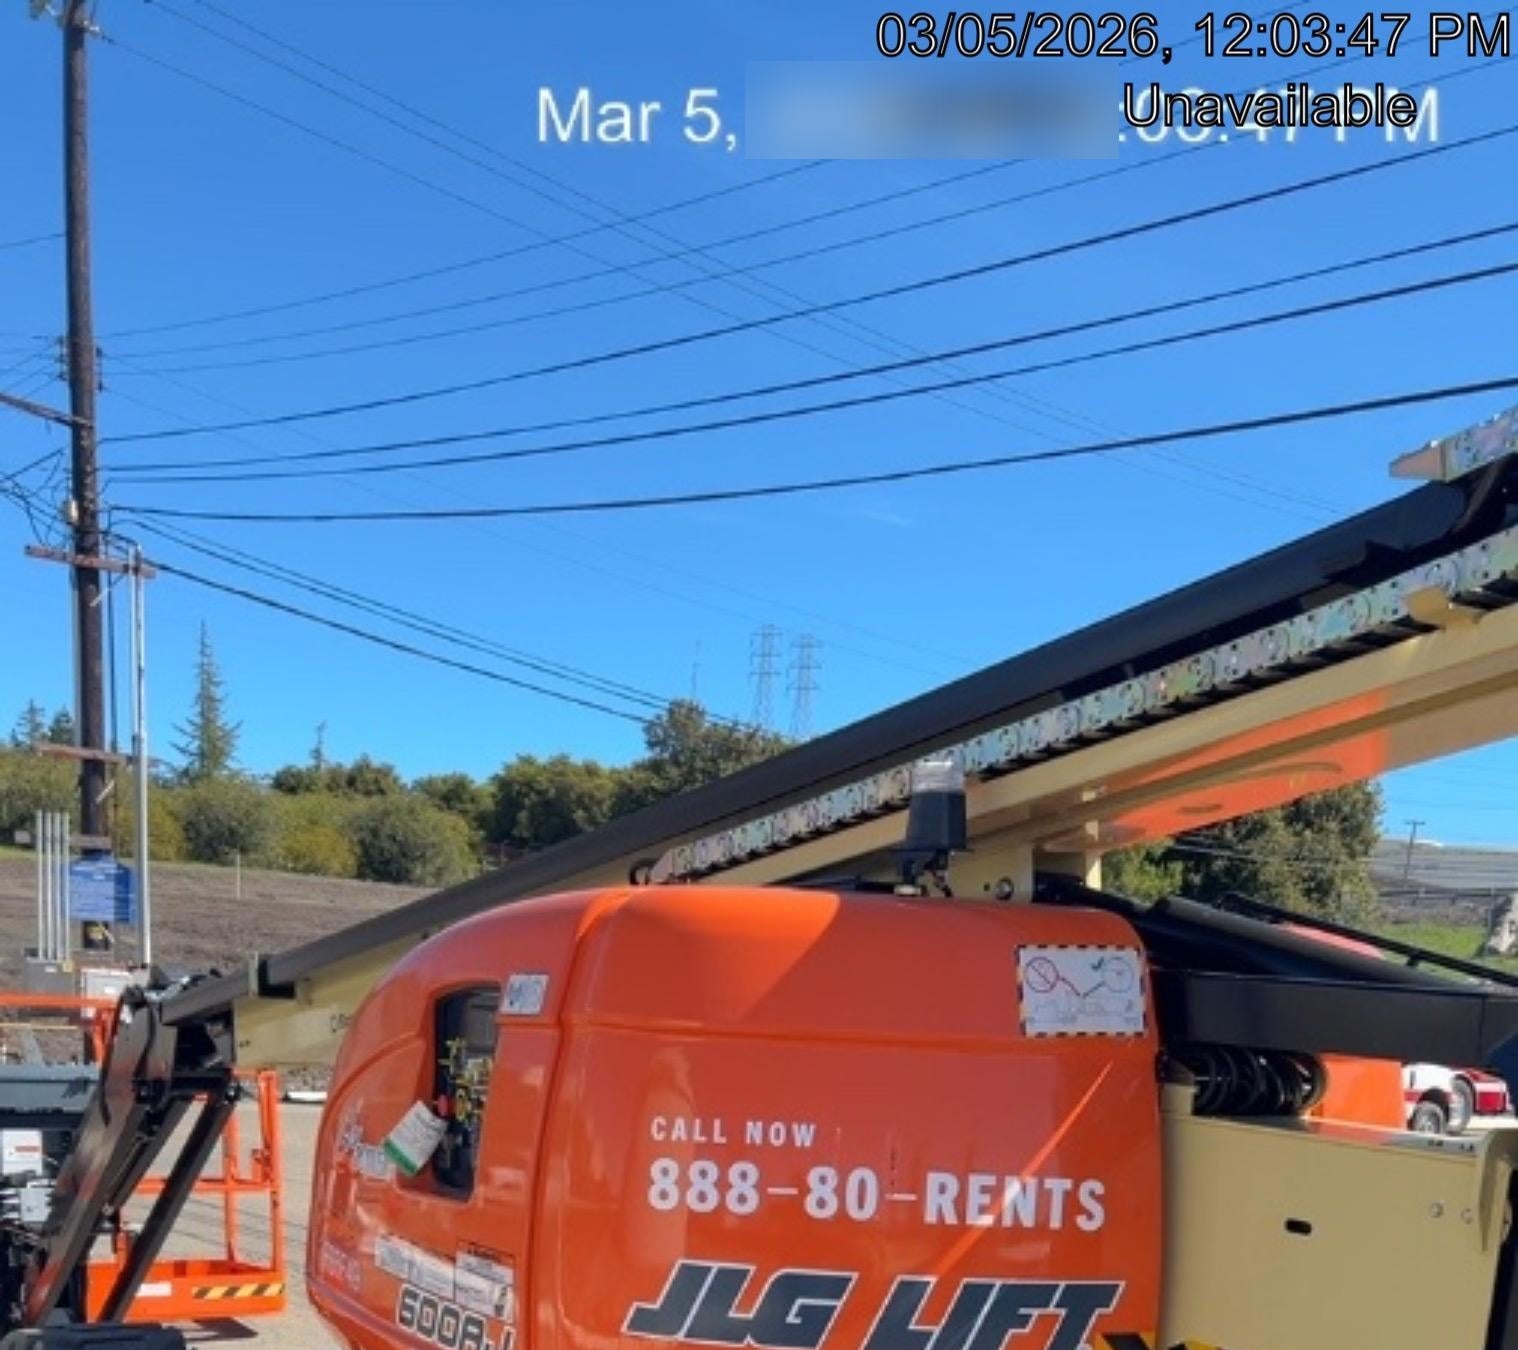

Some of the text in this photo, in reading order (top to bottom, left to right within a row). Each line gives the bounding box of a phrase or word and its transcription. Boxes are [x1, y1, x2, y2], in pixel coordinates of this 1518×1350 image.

[650, 1115, 818, 1149] CALL NOW
[647, 1157, 1106, 1232] 888-80-RENTS
